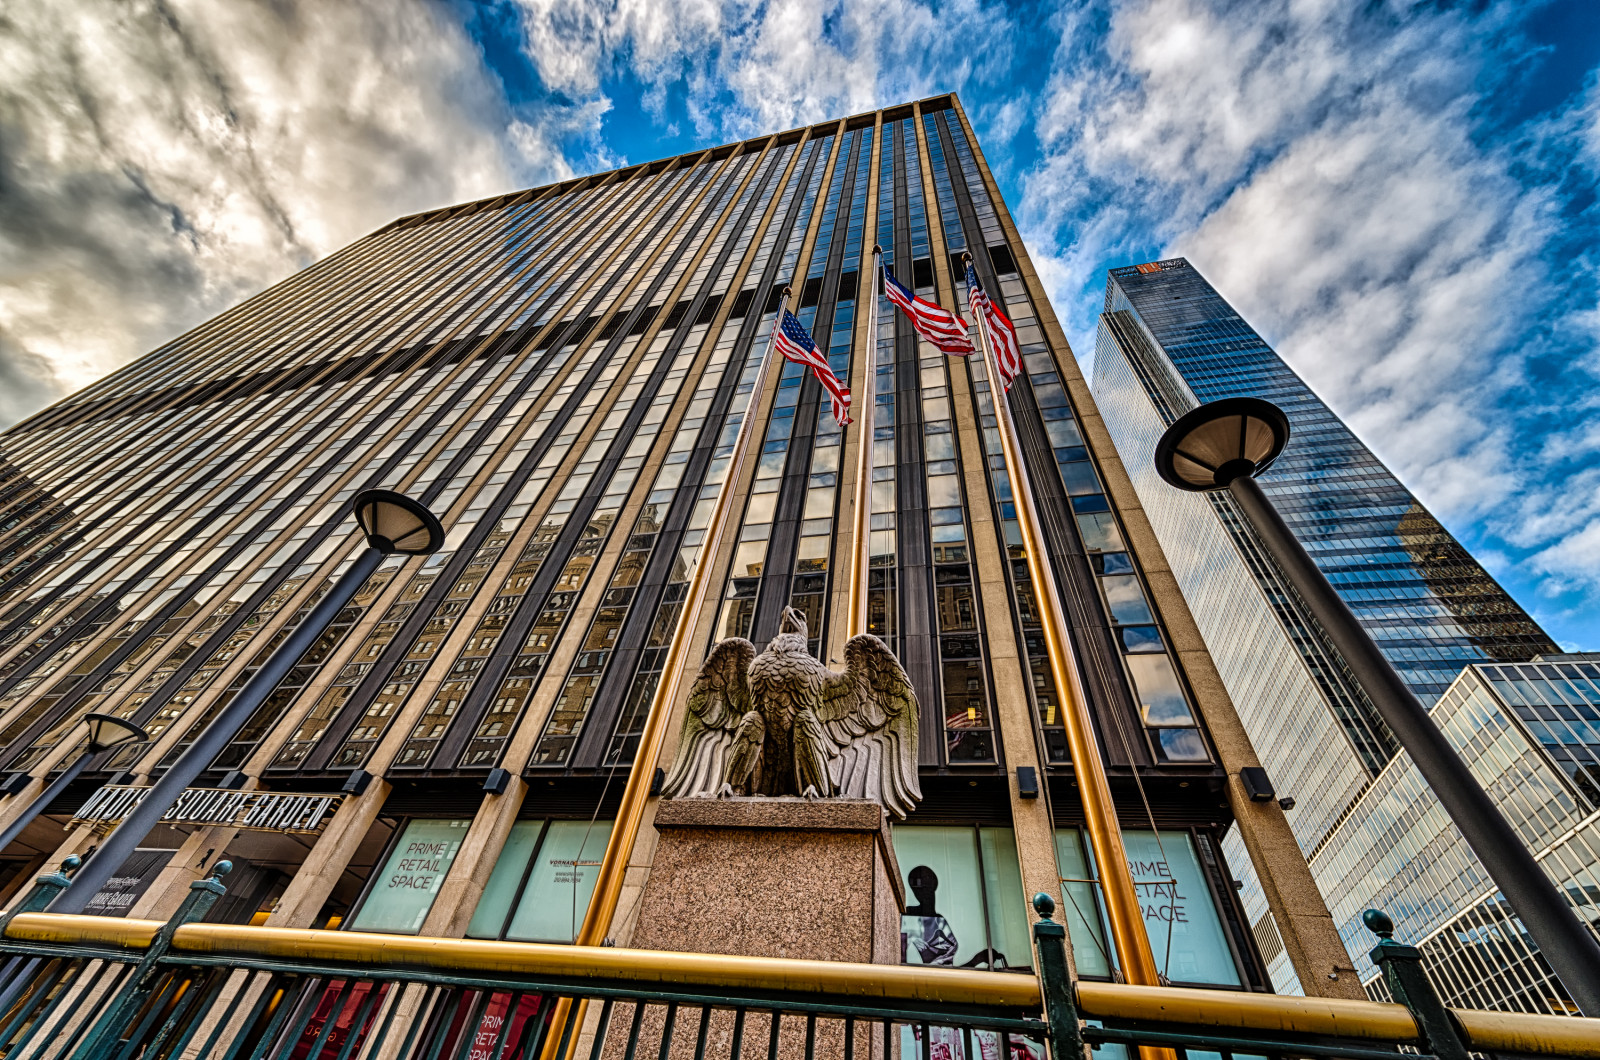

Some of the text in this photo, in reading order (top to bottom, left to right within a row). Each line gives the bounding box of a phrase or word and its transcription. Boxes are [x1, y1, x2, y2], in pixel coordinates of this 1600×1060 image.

[164, 789, 253, 823] SQUARE
[243, 793, 333, 830] GARDEN
[406, 842, 448, 856] PRIME
[397, 858, 440, 872] RETAIL
[1128, 861, 1172, 877] RIME
[388, 875, 433, 890] SPACE
